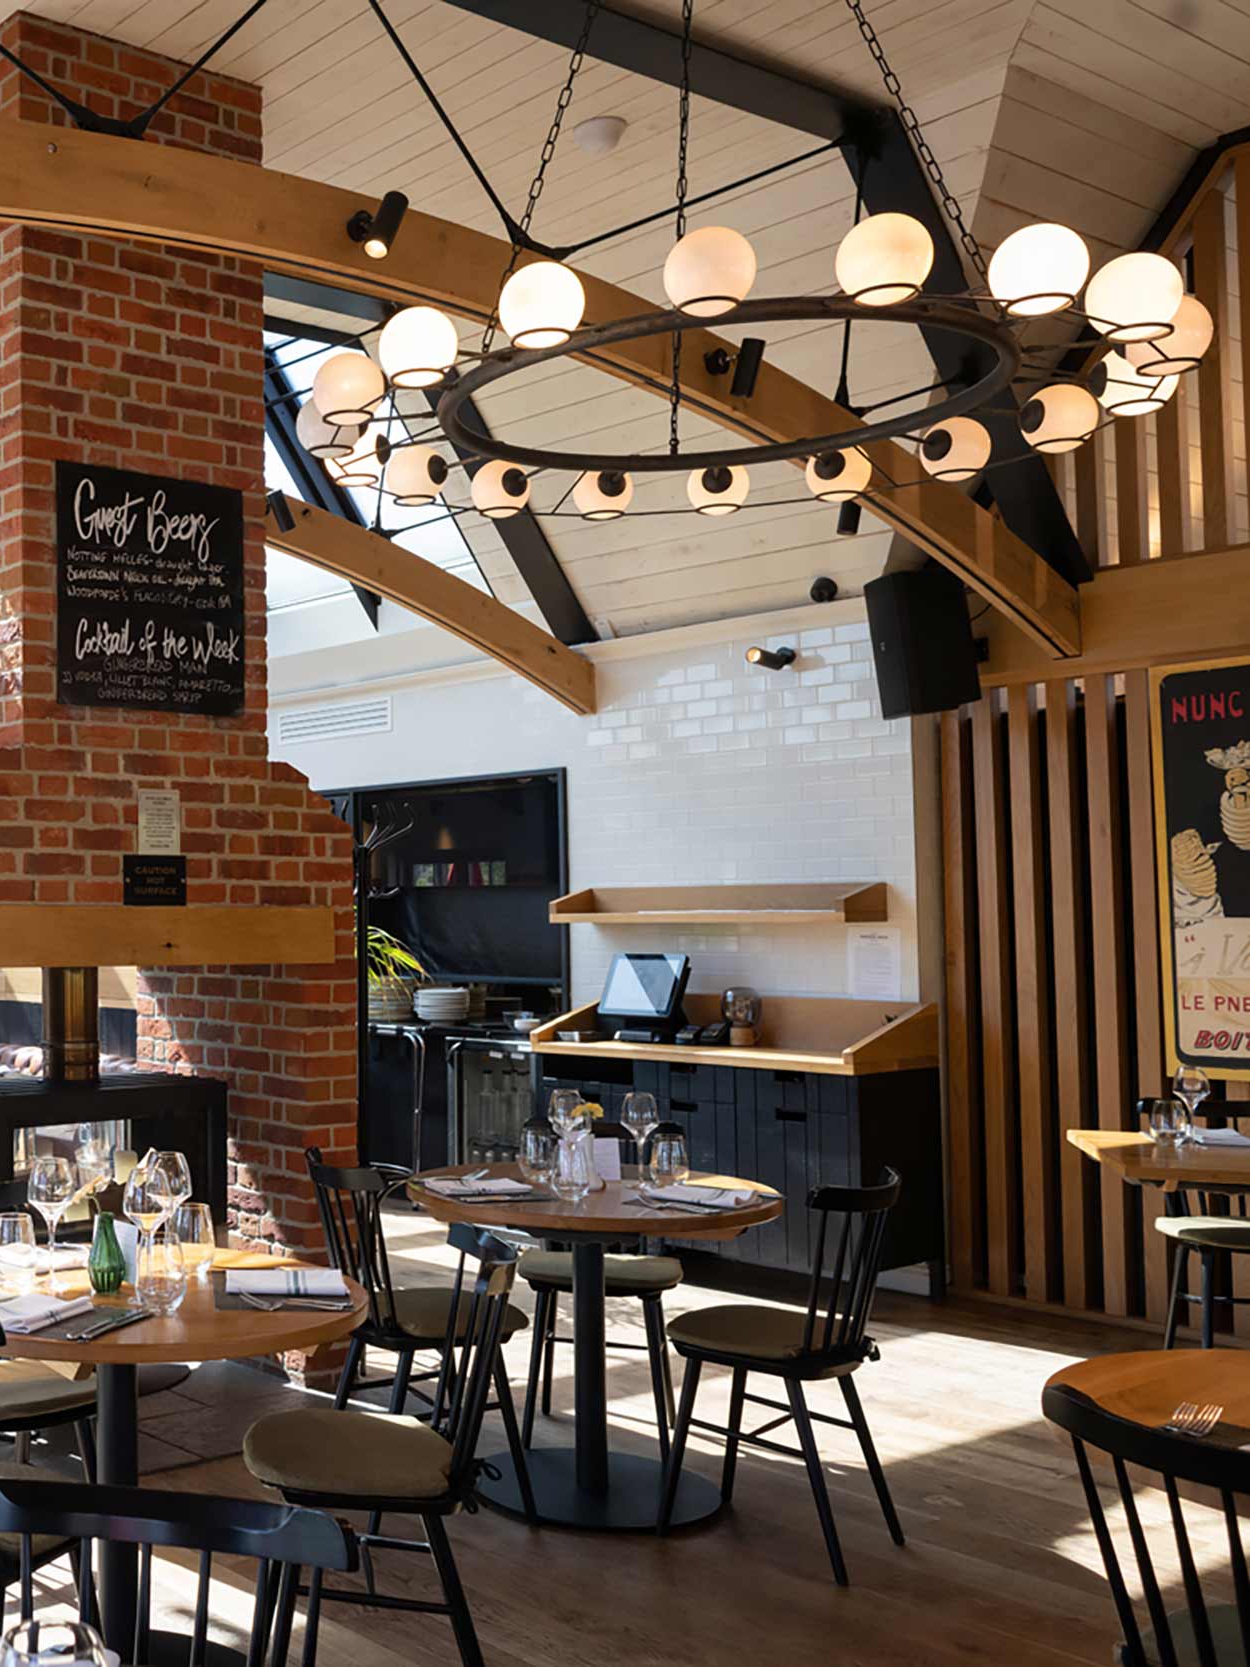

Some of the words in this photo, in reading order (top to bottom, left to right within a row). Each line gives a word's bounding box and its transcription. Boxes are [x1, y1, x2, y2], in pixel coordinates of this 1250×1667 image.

[74, 478, 144, 548] Guest
[147, 489, 220, 562] Beers
[75, 617, 135, 660] Cocktail
[139, 620, 157, 667] of
[162, 626, 188, 658] the
[192, 621, 240, 664] Week
[1171, 690, 1244, 724] NUNC
[1181, 995, 1206, 1010] LE
